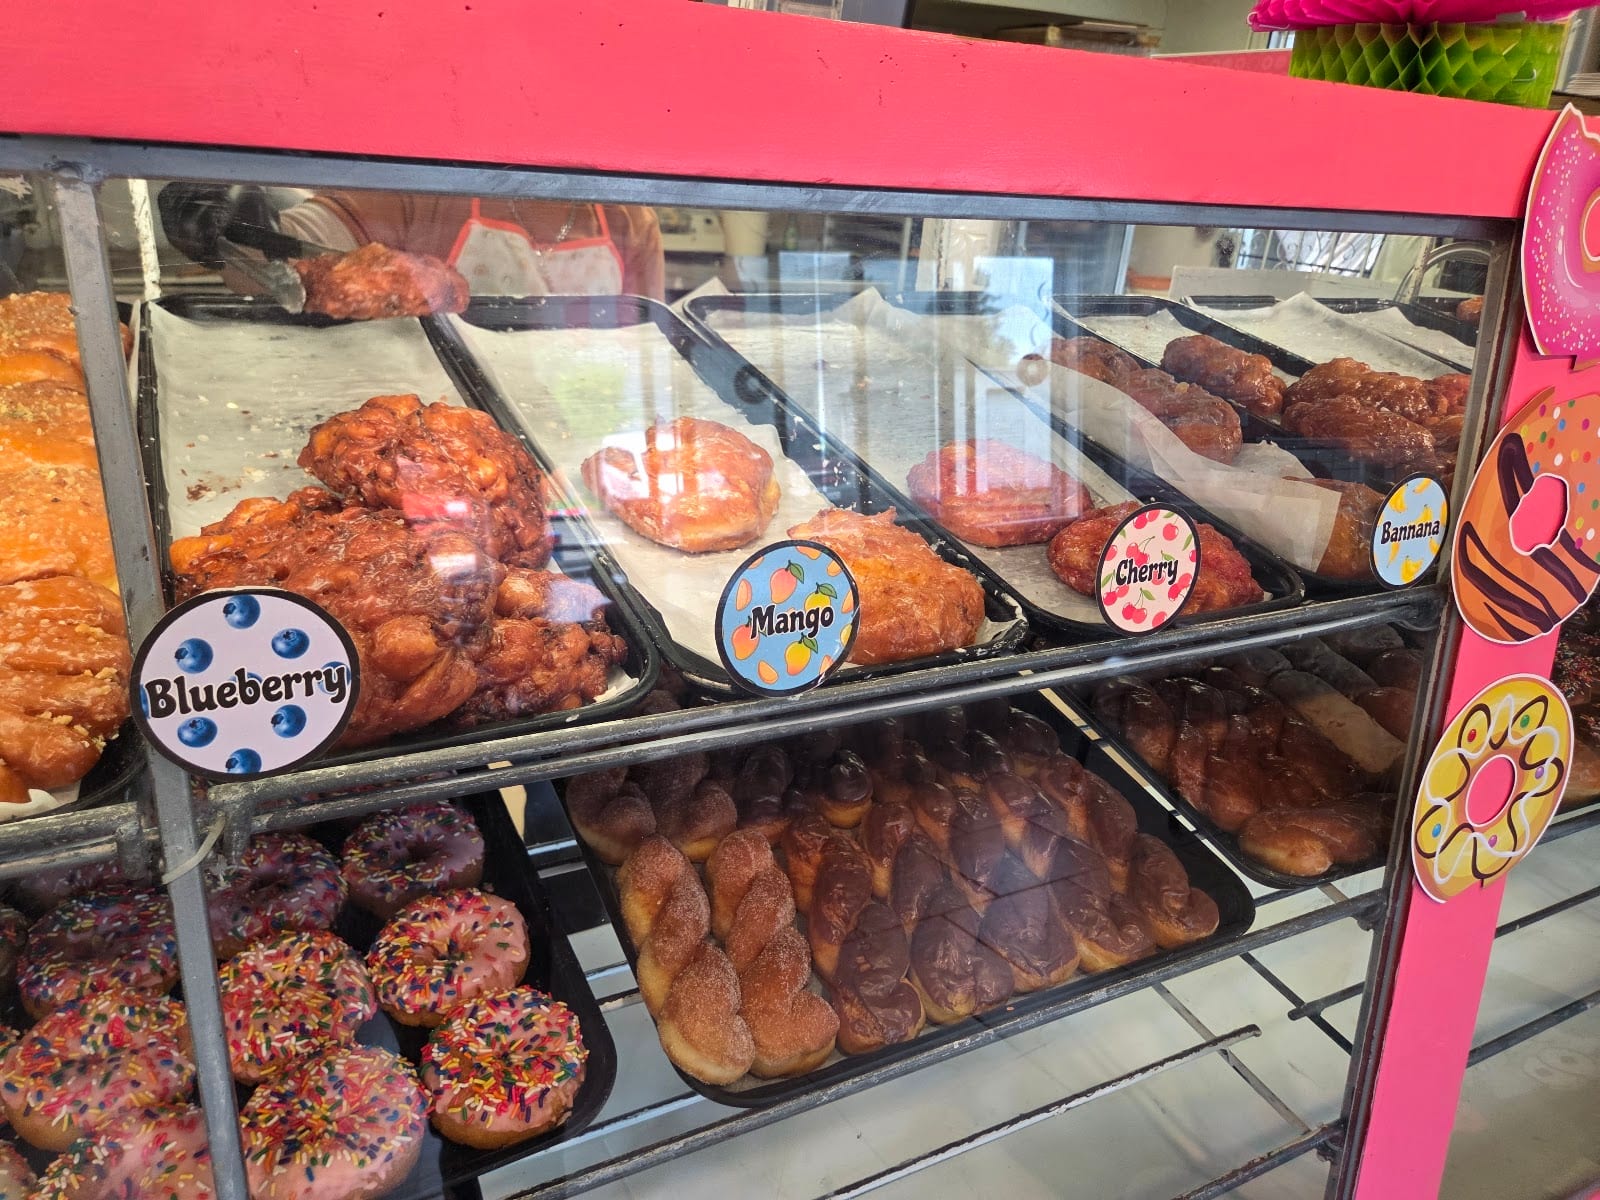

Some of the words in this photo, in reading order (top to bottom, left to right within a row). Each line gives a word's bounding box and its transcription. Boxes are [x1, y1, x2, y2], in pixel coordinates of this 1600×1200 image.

[1381, 520, 1440, 544] Bannana
[1116, 559, 1178, 585] Cherry
[750, 605, 834, 640] Mango
[145, 667, 346, 718] Blueberry
